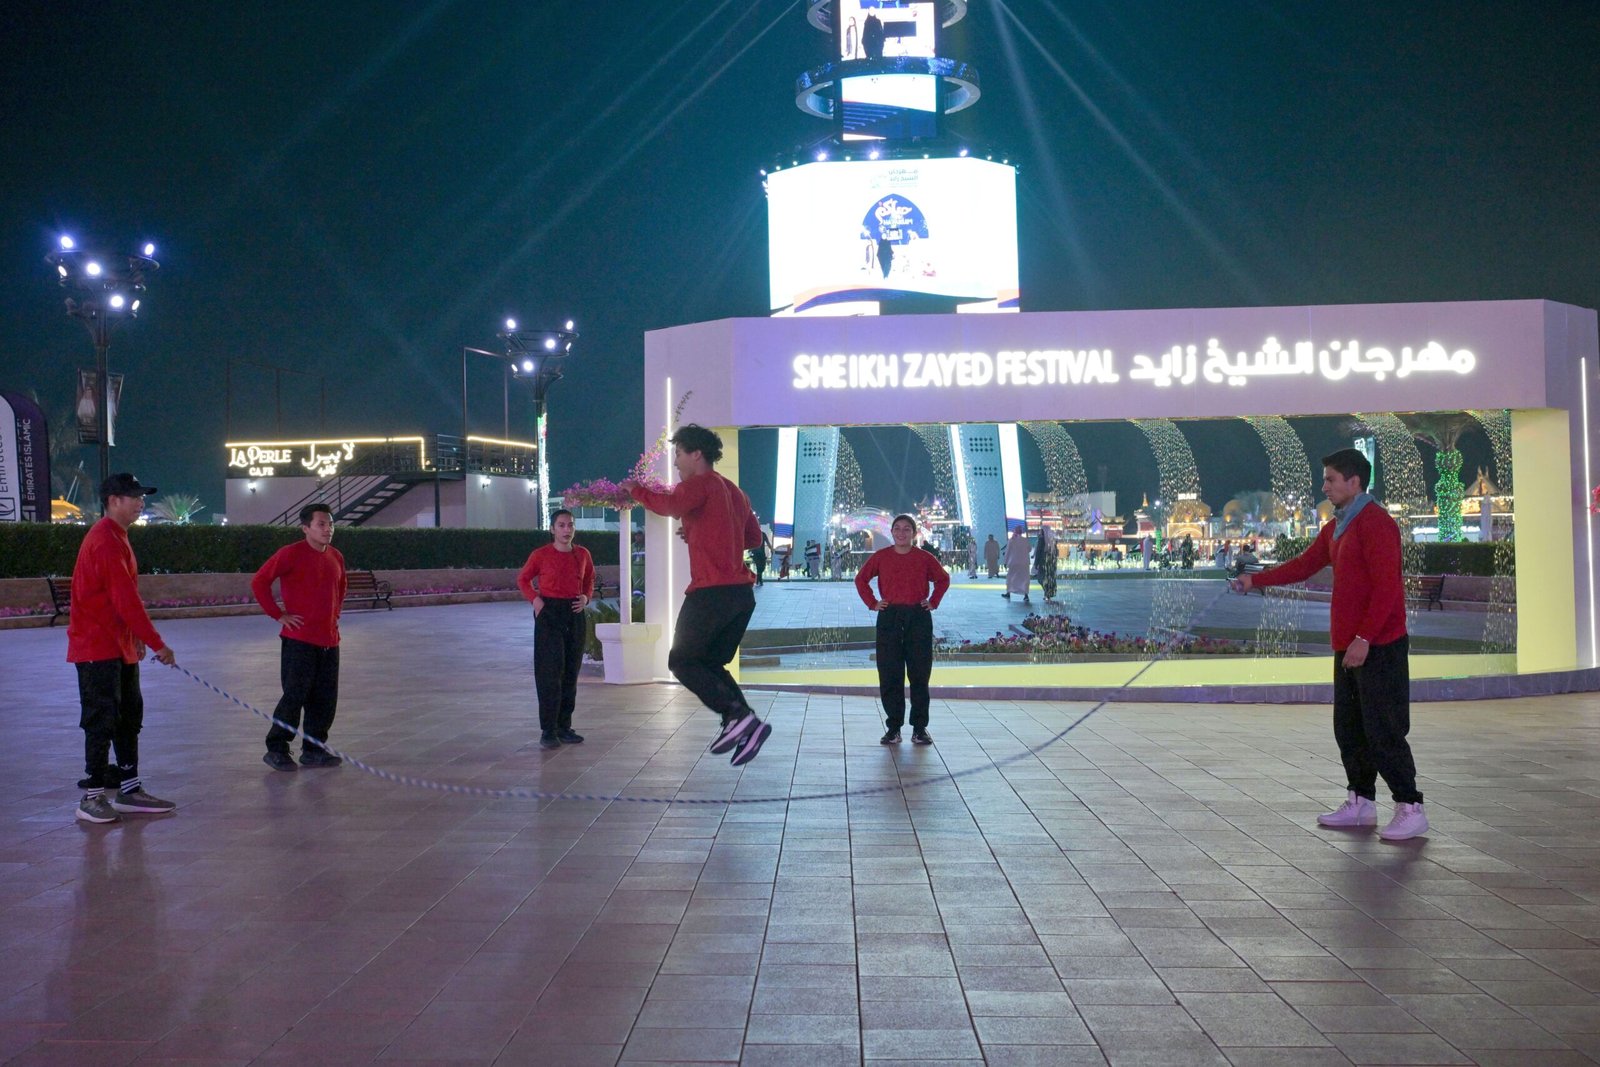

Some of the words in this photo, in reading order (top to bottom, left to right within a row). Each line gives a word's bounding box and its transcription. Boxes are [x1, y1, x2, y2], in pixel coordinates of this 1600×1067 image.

[793, 354, 899, 389] SHEIKH
[903, 352, 993, 387] ZAYED
[996, 349, 1120, 385] FESTIVAL
[1129, 345, 1198, 387] زايد
[1203, 337, 1314, 386] الشيخ
[1319, 340, 1476, 381] مهرجان
[22, 418, 32, 455] ISLAMIC
[247, 445, 292, 466] PERLE
[24, 457, 36, 500] EMIRATES
